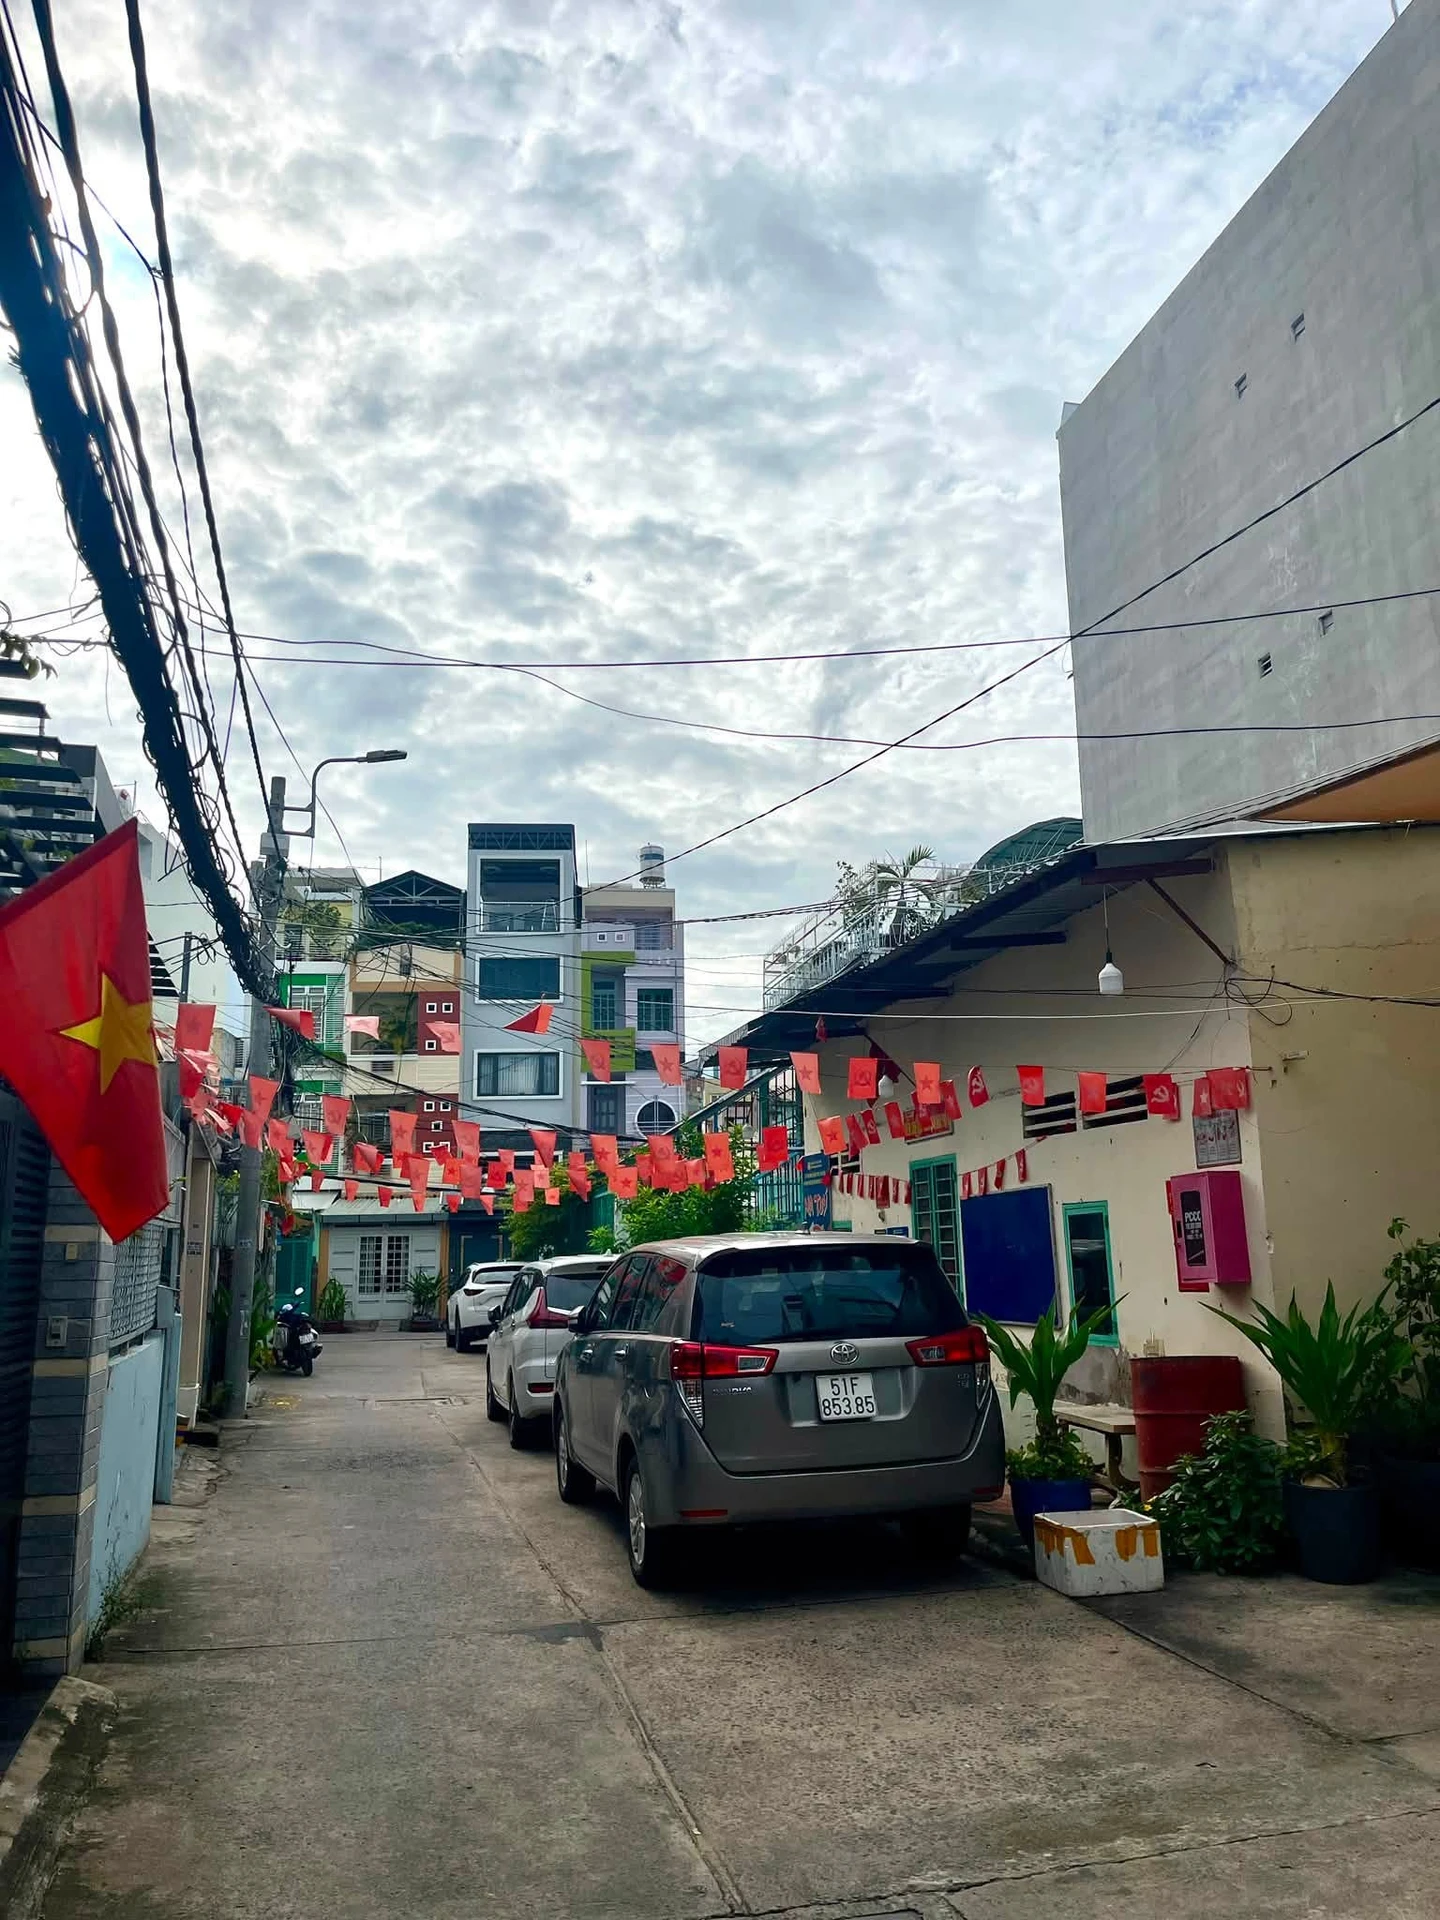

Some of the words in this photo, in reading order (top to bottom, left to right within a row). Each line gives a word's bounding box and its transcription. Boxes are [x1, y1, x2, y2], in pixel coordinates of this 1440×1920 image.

[1184, 1210, 1201, 1223] PCCC
[830, 1377, 859, 1396] 51F
[822, 1395, 875, 1416] 853.85
